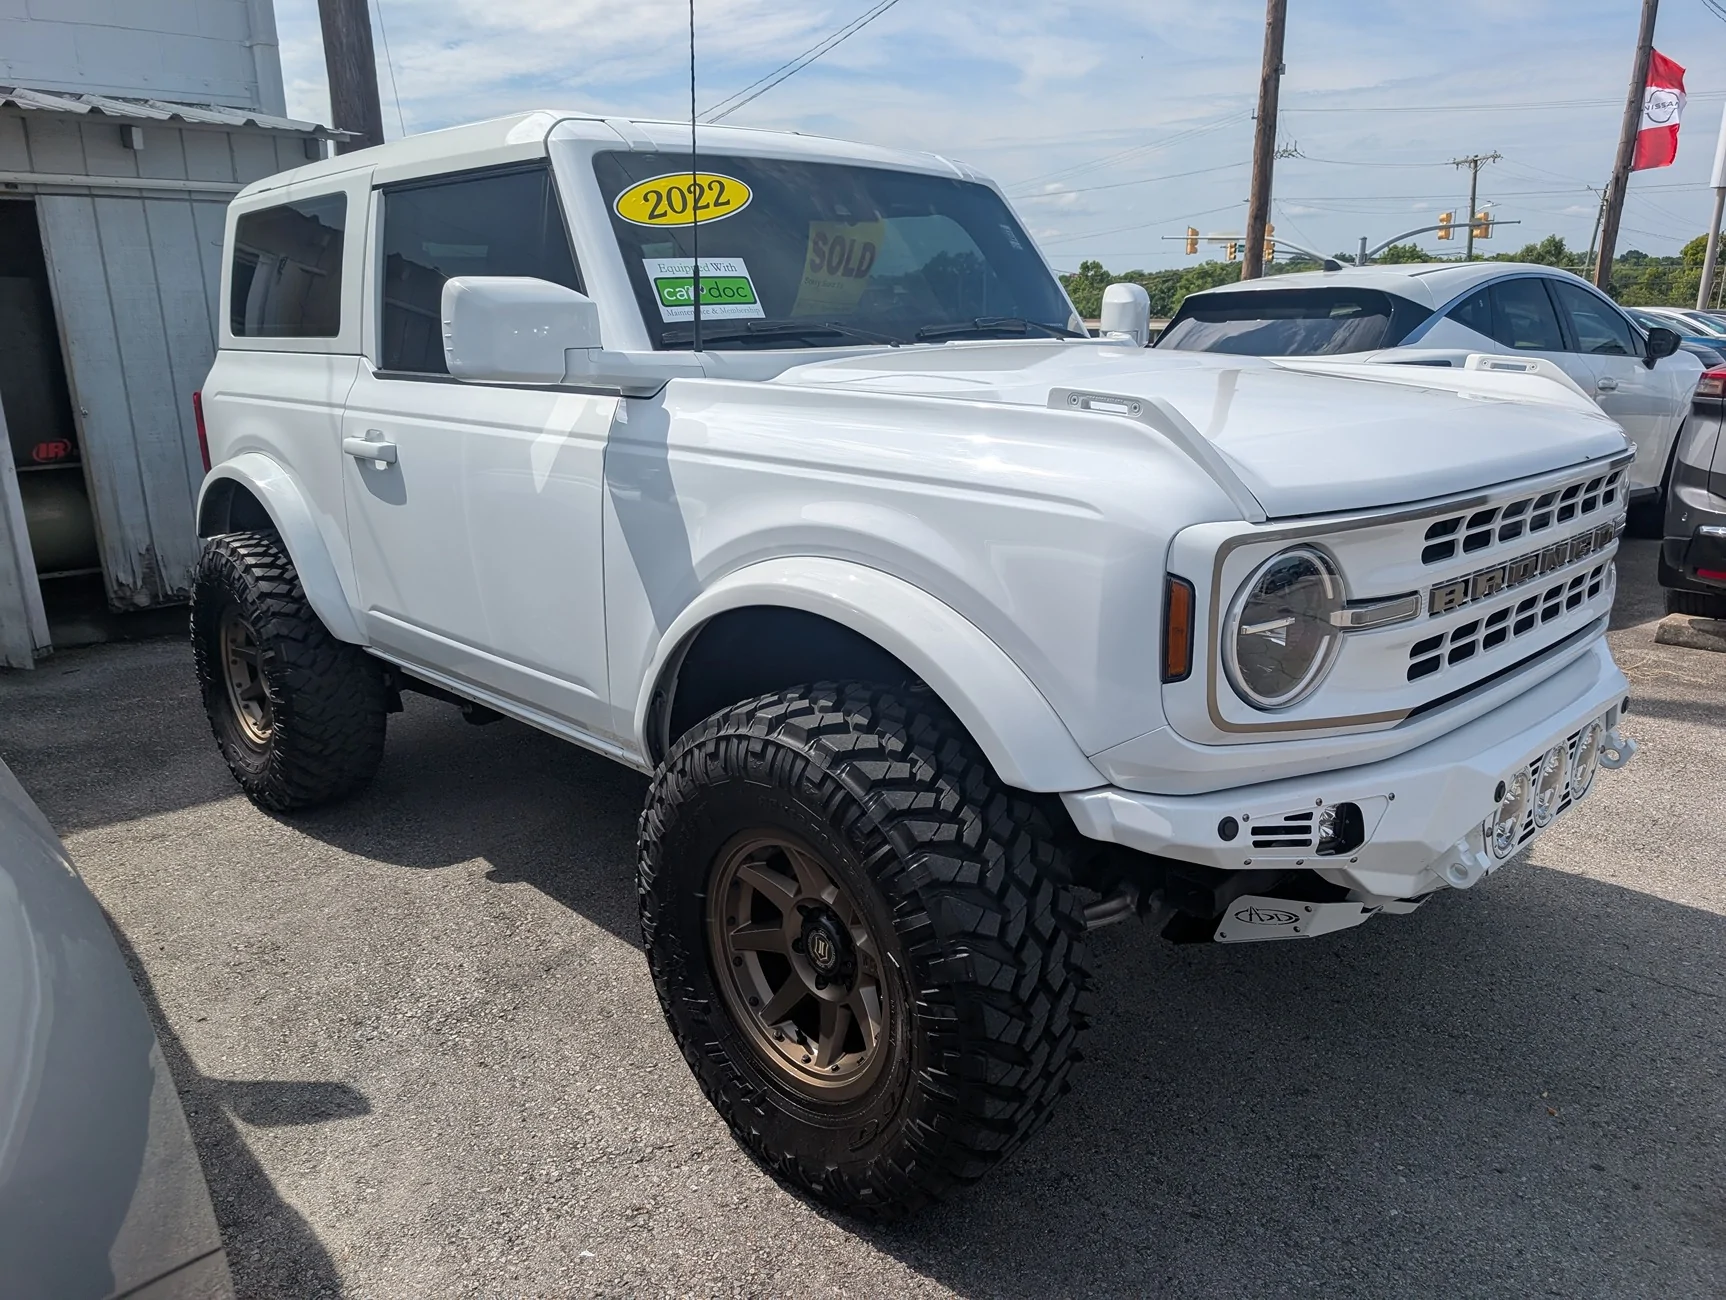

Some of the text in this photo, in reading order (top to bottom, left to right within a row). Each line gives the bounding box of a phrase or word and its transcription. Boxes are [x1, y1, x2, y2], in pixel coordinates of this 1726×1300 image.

[643, 179, 730, 220] 2022
[658, 262, 738, 275] Equiped With
[810, 231, 876, 279] SOLD
[667, 308, 710, 317] Maintence
[719, 307, 761, 317] Membership
[38, 441, 66, 458] IR
[1429, 523, 1615, 614] BRONCO
